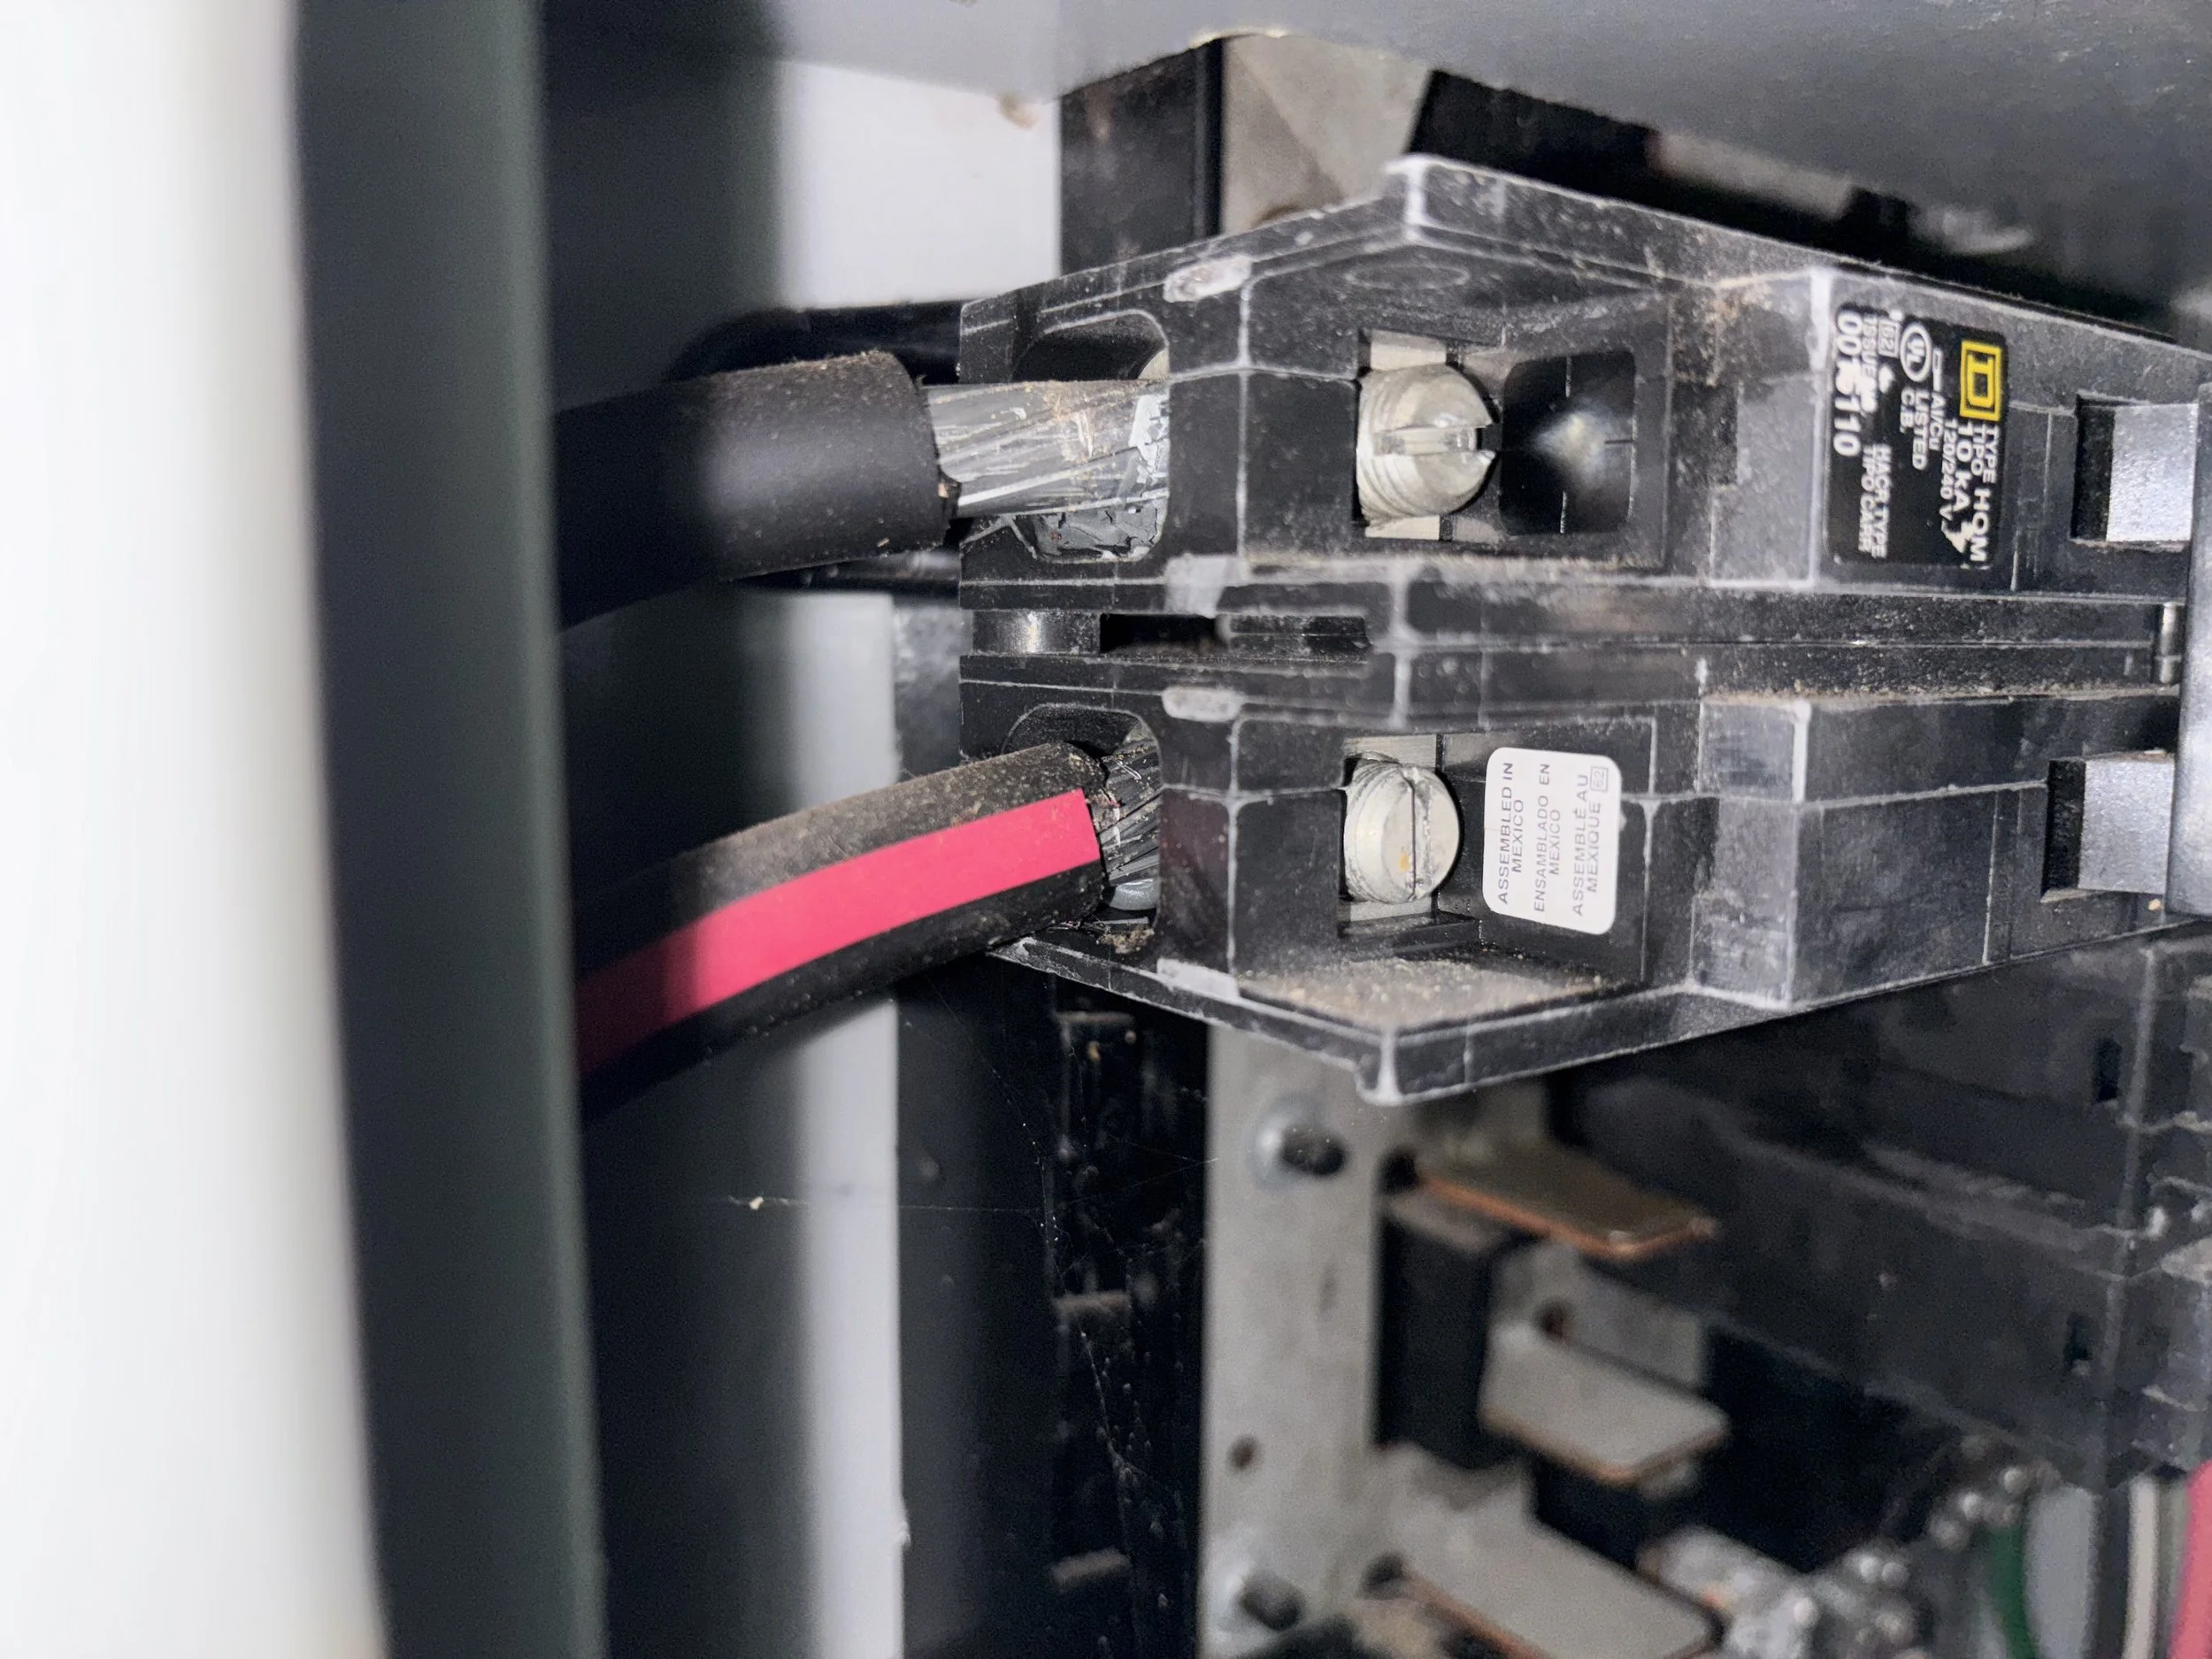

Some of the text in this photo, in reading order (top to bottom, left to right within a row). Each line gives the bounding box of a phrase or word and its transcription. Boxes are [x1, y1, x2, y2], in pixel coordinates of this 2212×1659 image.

[1861, 314, 1879, 378] ISSUE
[1907, 337, 1924, 370] UL
[1900, 388, 1915, 434] C.B.
[1912, 390, 1930, 471] LISTED
[1940, 418, 1958, 500] 120/240
[1953, 422, 1975, 511] 10 kA
[1970, 424, 1992, 562] TIPO HOM
[1983, 426, 2000, 484] TYPE
[1858, 444, 1876, 553] TIPO CARR
[1871, 443, 1893, 558] HACR TYPE
[1593, 770, 1606, 788] 62
[1497, 762, 1513, 905] ASSEMBLED IN
[1511, 799, 1524, 873] MEXICO
[1533, 764, 1550, 912] ENSAMBLADO EN
[1549, 809, 1561, 875] MEXICO
[1572, 774, 1588, 917] ASSEMBLÉ AU
[1586, 802, 1601, 894] MEXIQUE
